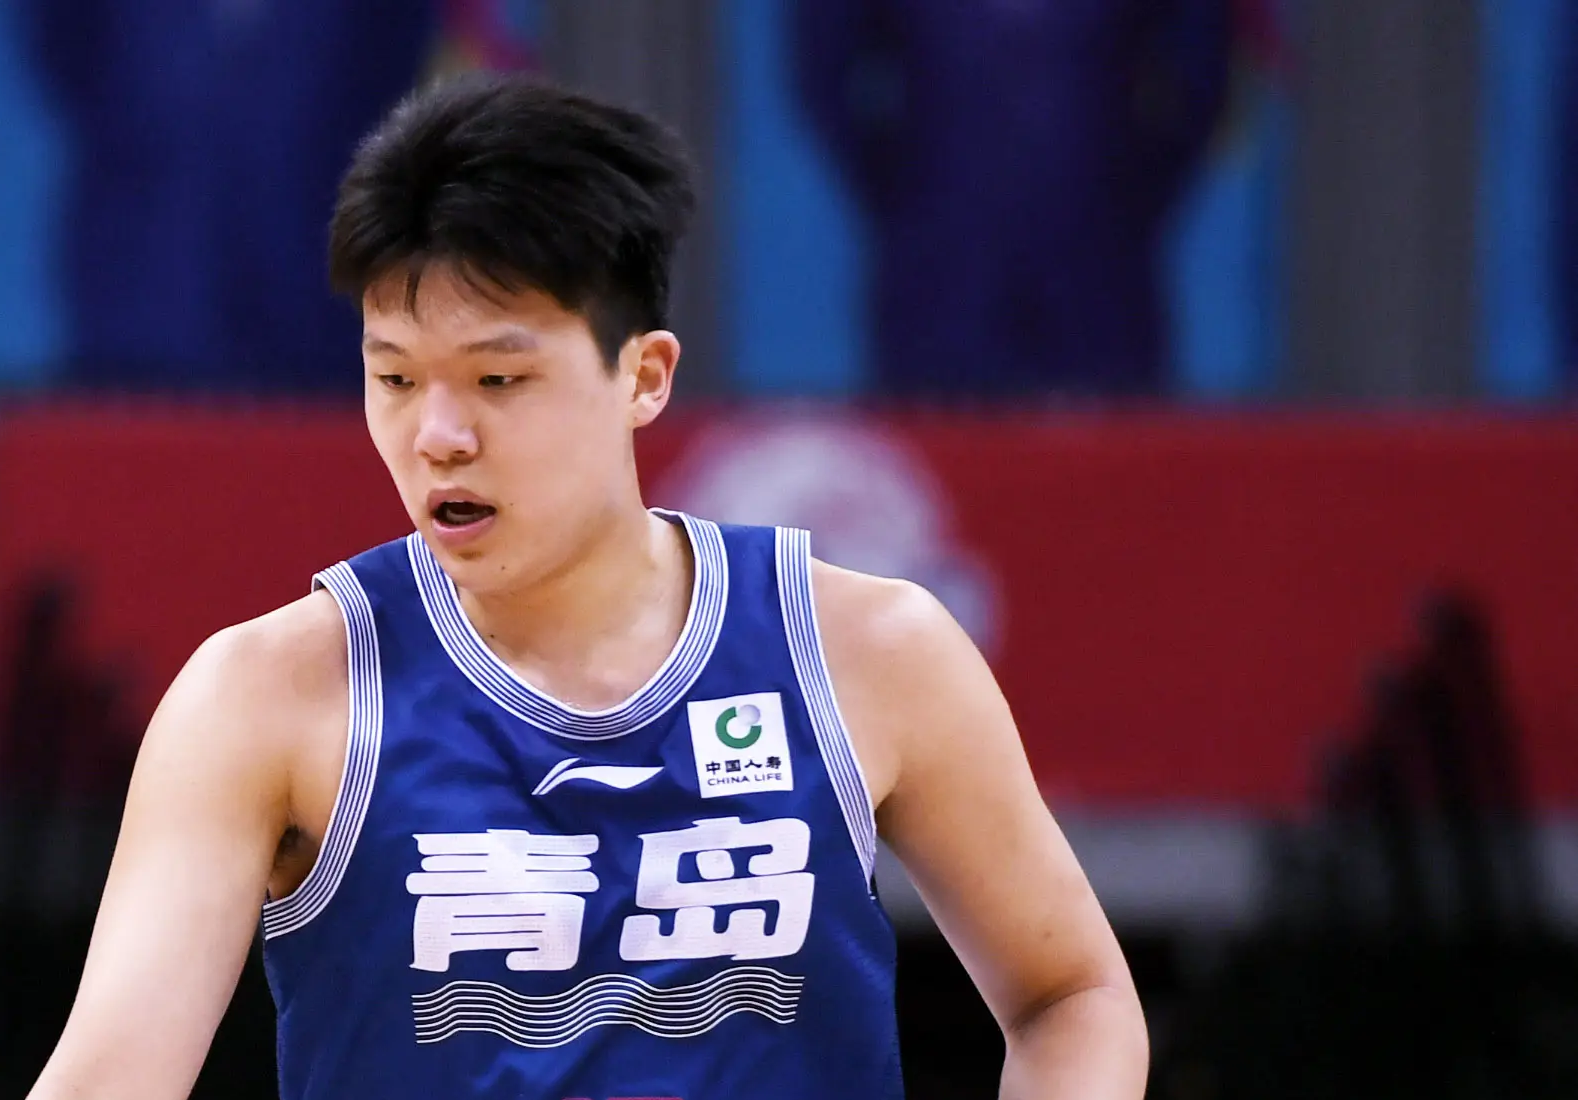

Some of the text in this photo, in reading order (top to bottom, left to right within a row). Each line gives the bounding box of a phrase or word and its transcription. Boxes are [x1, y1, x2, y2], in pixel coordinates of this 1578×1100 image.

[705, 756, 782, 774] 中国人寿
[707, 773, 783, 786] CHINA LIFE
[406, 816, 815, 972] 青岛
